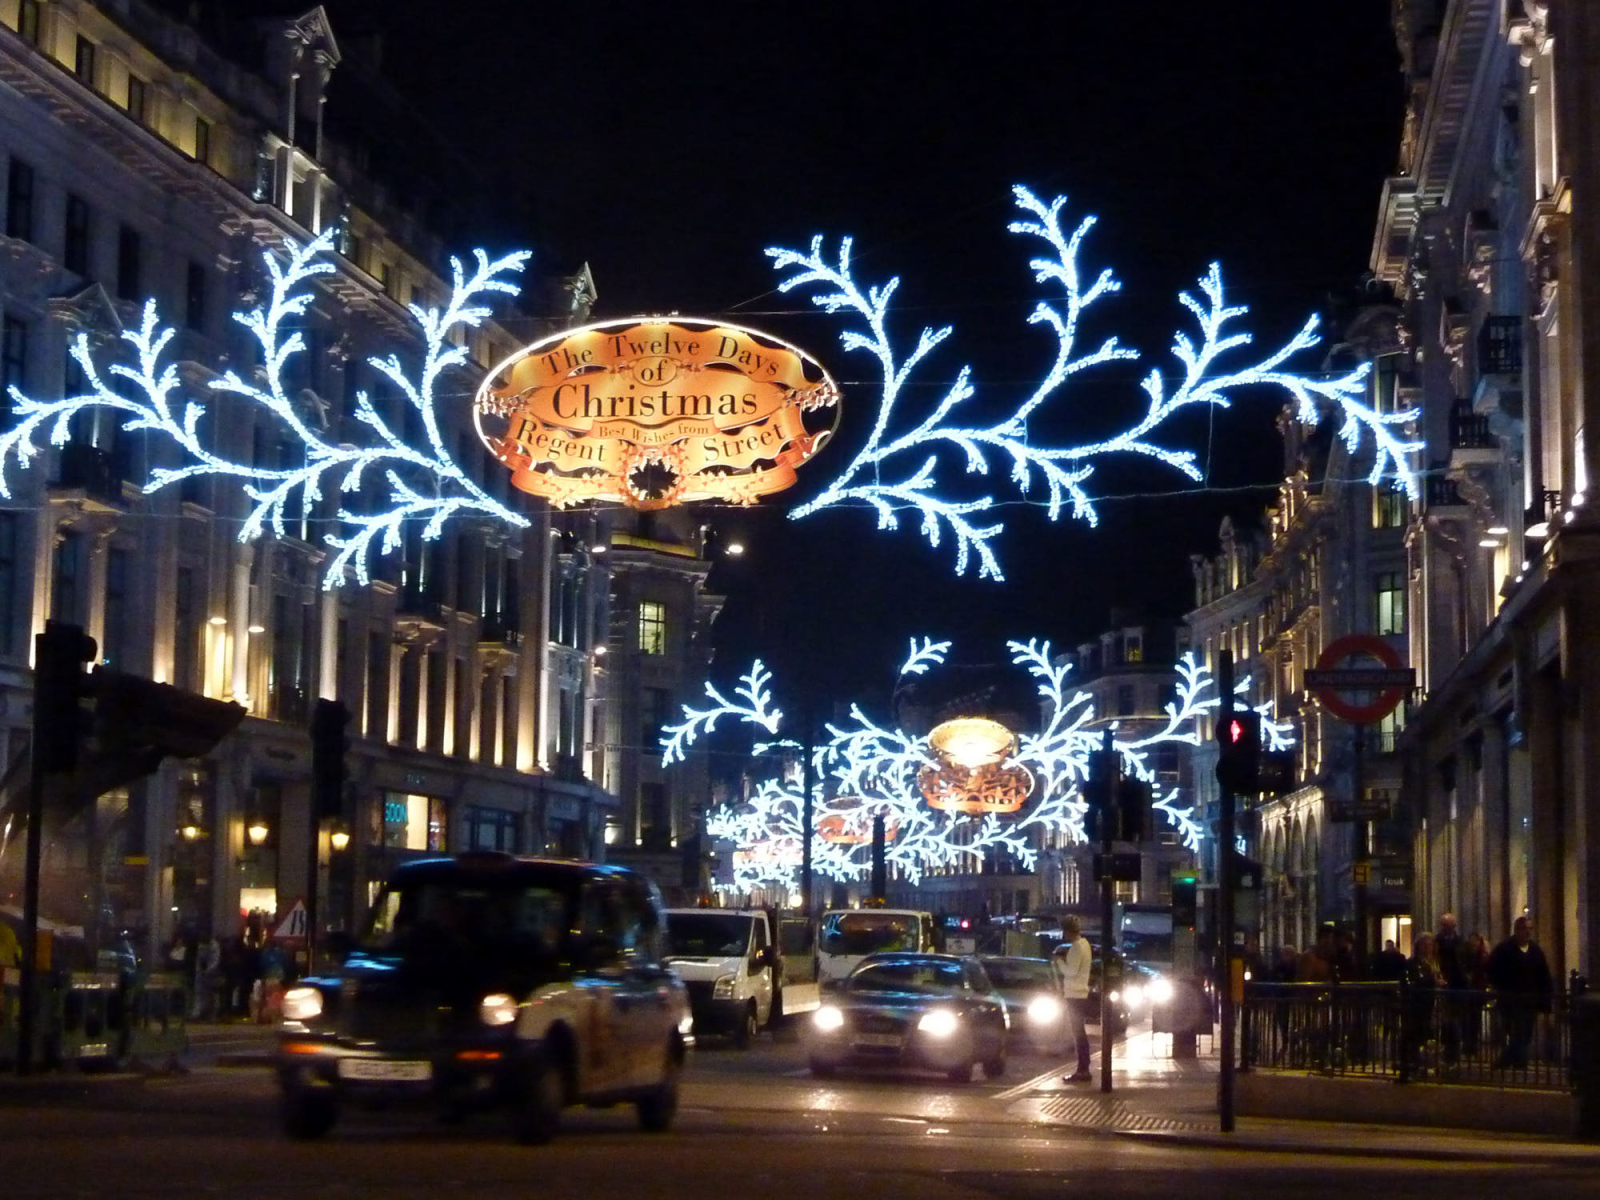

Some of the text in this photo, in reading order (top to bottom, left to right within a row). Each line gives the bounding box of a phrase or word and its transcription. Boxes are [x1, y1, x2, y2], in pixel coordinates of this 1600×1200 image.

[541, 332, 780, 376] The Twelve Days
[641, 359, 667, 382] of
[552, 383, 758, 420] Christmas
[514, 418, 607, 462] Regent
[599, 422, 710, 443] Best Wishes from
[702, 422, 786, 462] Street
